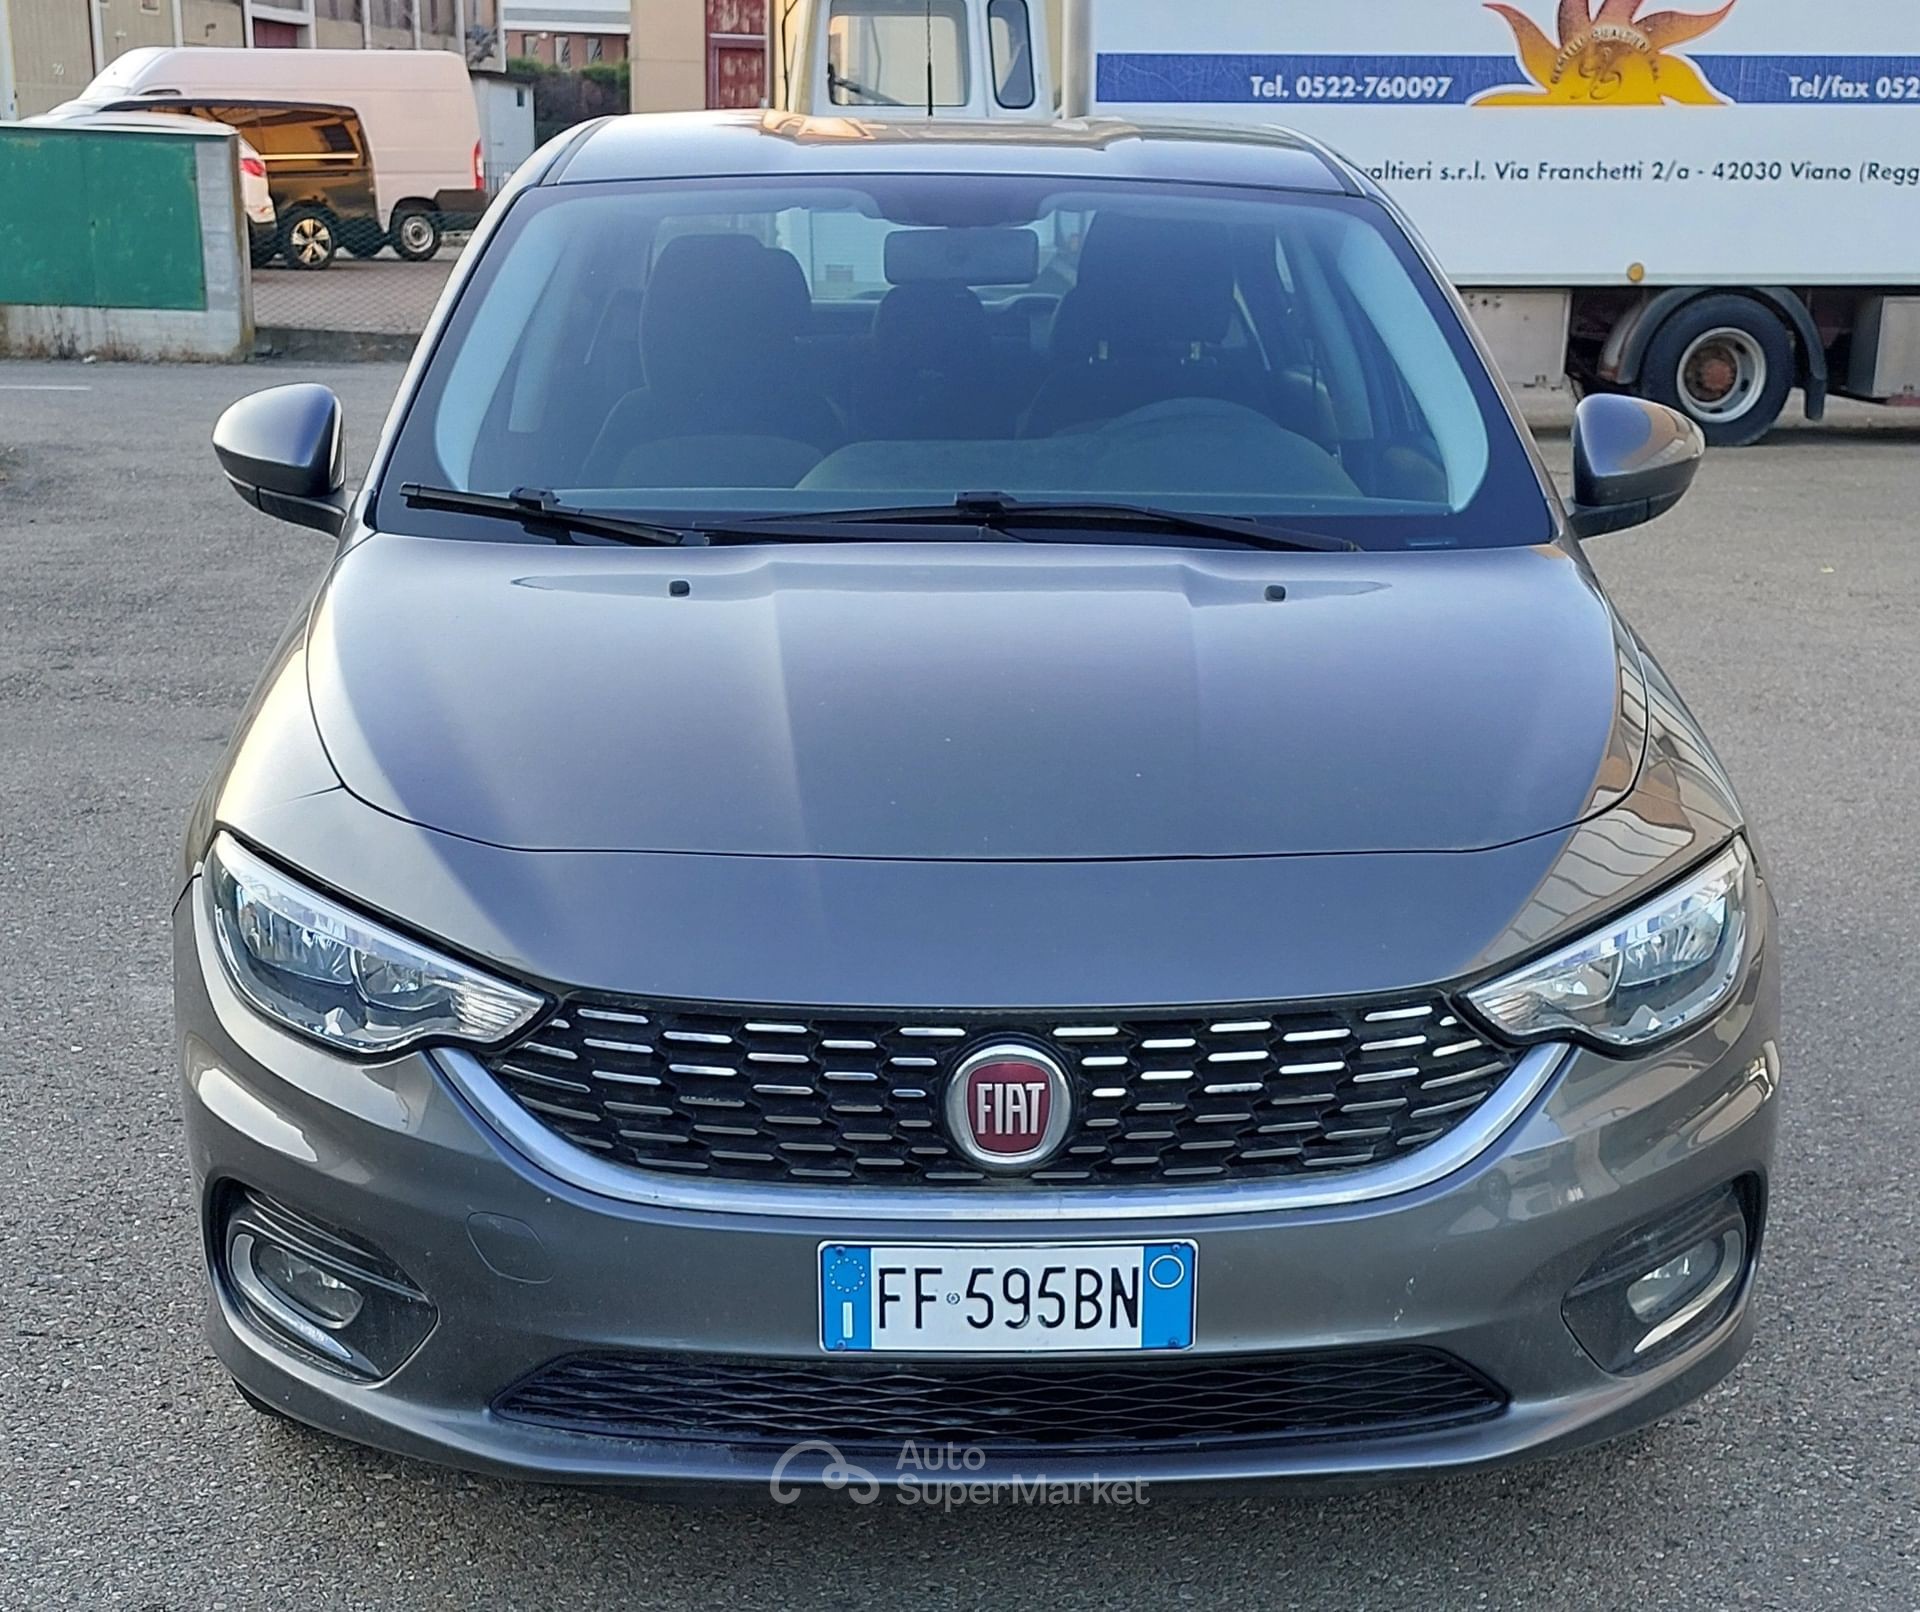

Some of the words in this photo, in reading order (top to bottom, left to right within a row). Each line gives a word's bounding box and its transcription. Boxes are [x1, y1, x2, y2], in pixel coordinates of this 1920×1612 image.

[1250, 75, 1289, 97] Tel.
[1296, 75, 1453, 98] 0522-760097
[1789, 74, 1869, 99] Tel/fax
[1365, 160, 1432, 180] altieri
[1440, 160, 1486, 180] s.r.l.
[1496, 161, 1529, 180] Via
[1538, 160, 1644, 180] Franchetti
[1651, 160, 1689, 182] 2/a
[1712, 160, 1782, 180] 42030
[1790, 161, 1852, 180] Viano
[1859, 160, 1920, 186] (Regg
[976, 1082, 1046, 1135] FIAT
[878, 1266, 944, 1330] FF
[965, 1266, 1140, 1331] 595BN
